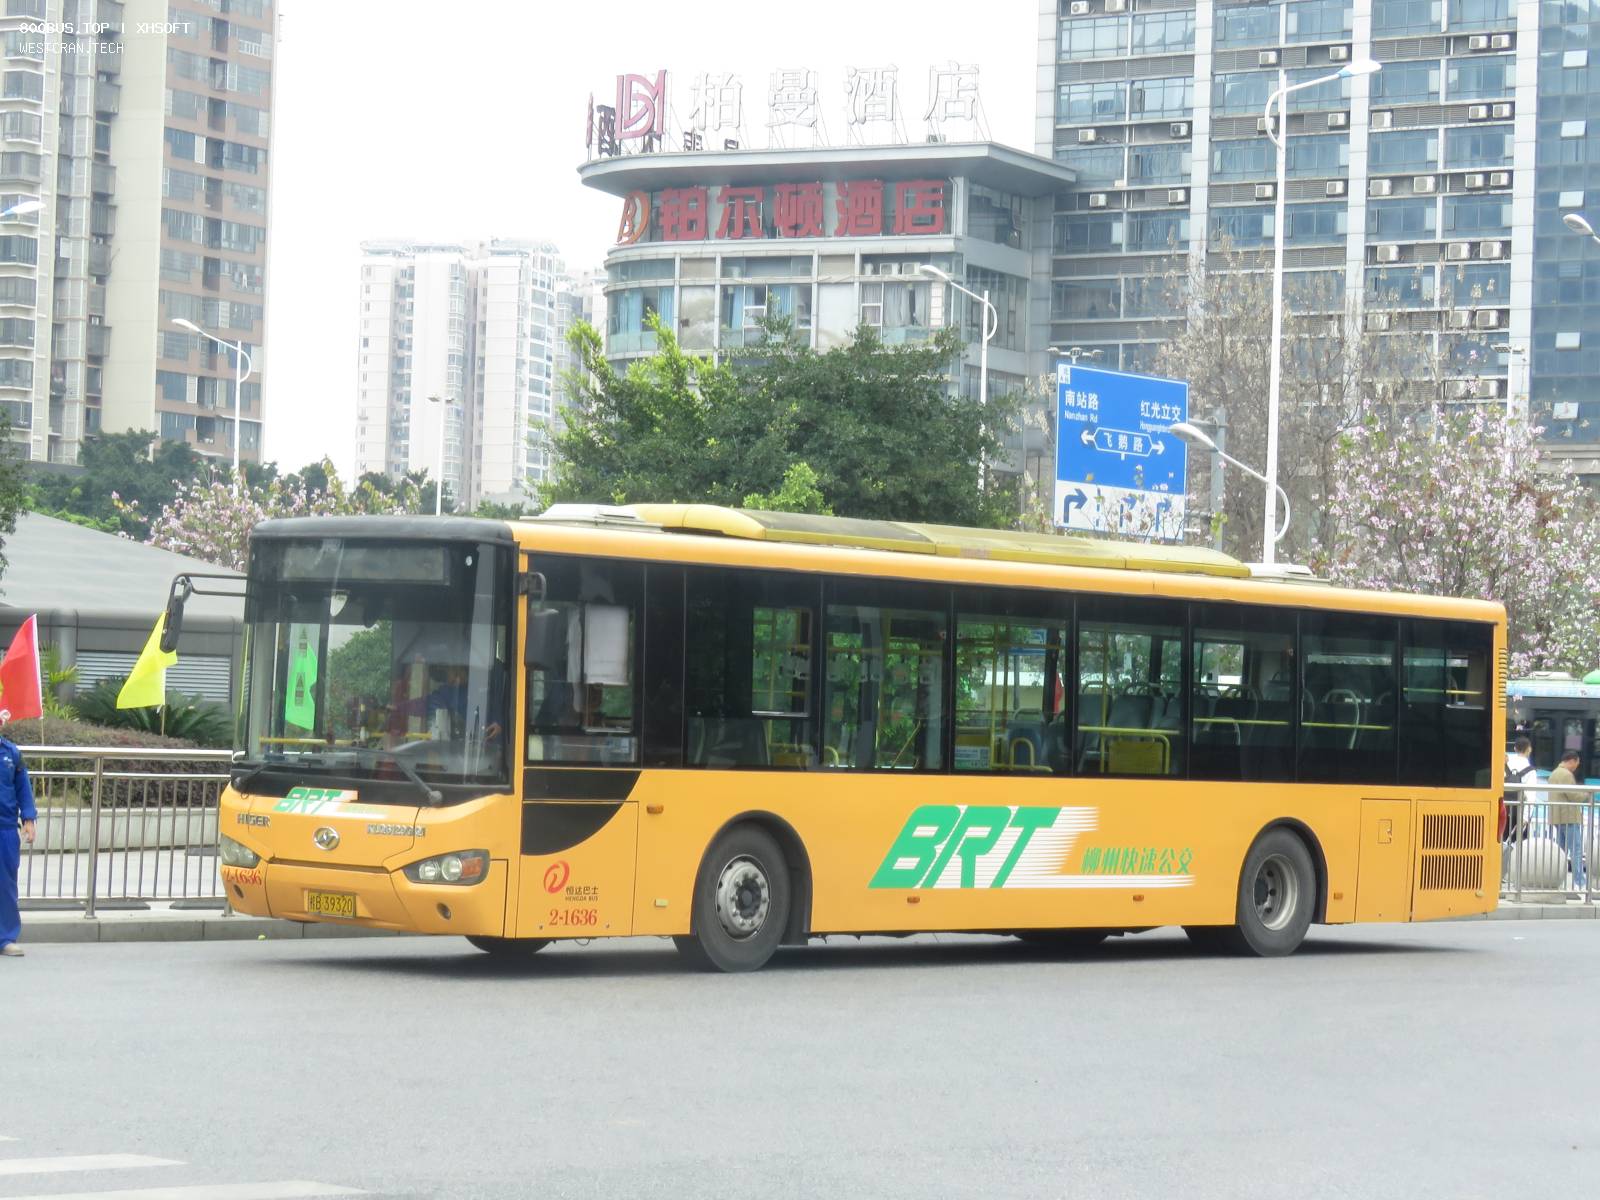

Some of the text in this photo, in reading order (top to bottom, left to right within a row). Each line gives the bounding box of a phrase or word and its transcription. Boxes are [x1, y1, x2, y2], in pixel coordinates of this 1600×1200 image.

[690, 62, 979, 130] 柏曼酒店
[659, 179, 946, 242] 铂尔顿酒店
[1065, 389, 1099, 411] 南站路
[1140, 400, 1182, 422] 红光立交
[1103, 432, 1144, 453] 飞鹅路
[272, 786, 343, 815] BRT
[237, 813, 271, 828] HIGER
[867, 804, 1063, 889] BRT
[1080, 847, 1194, 875] 柳州快速公交
[566, 886, 599, 896] 恒达巴士
[548, 909, 598, 926] 2-1636
